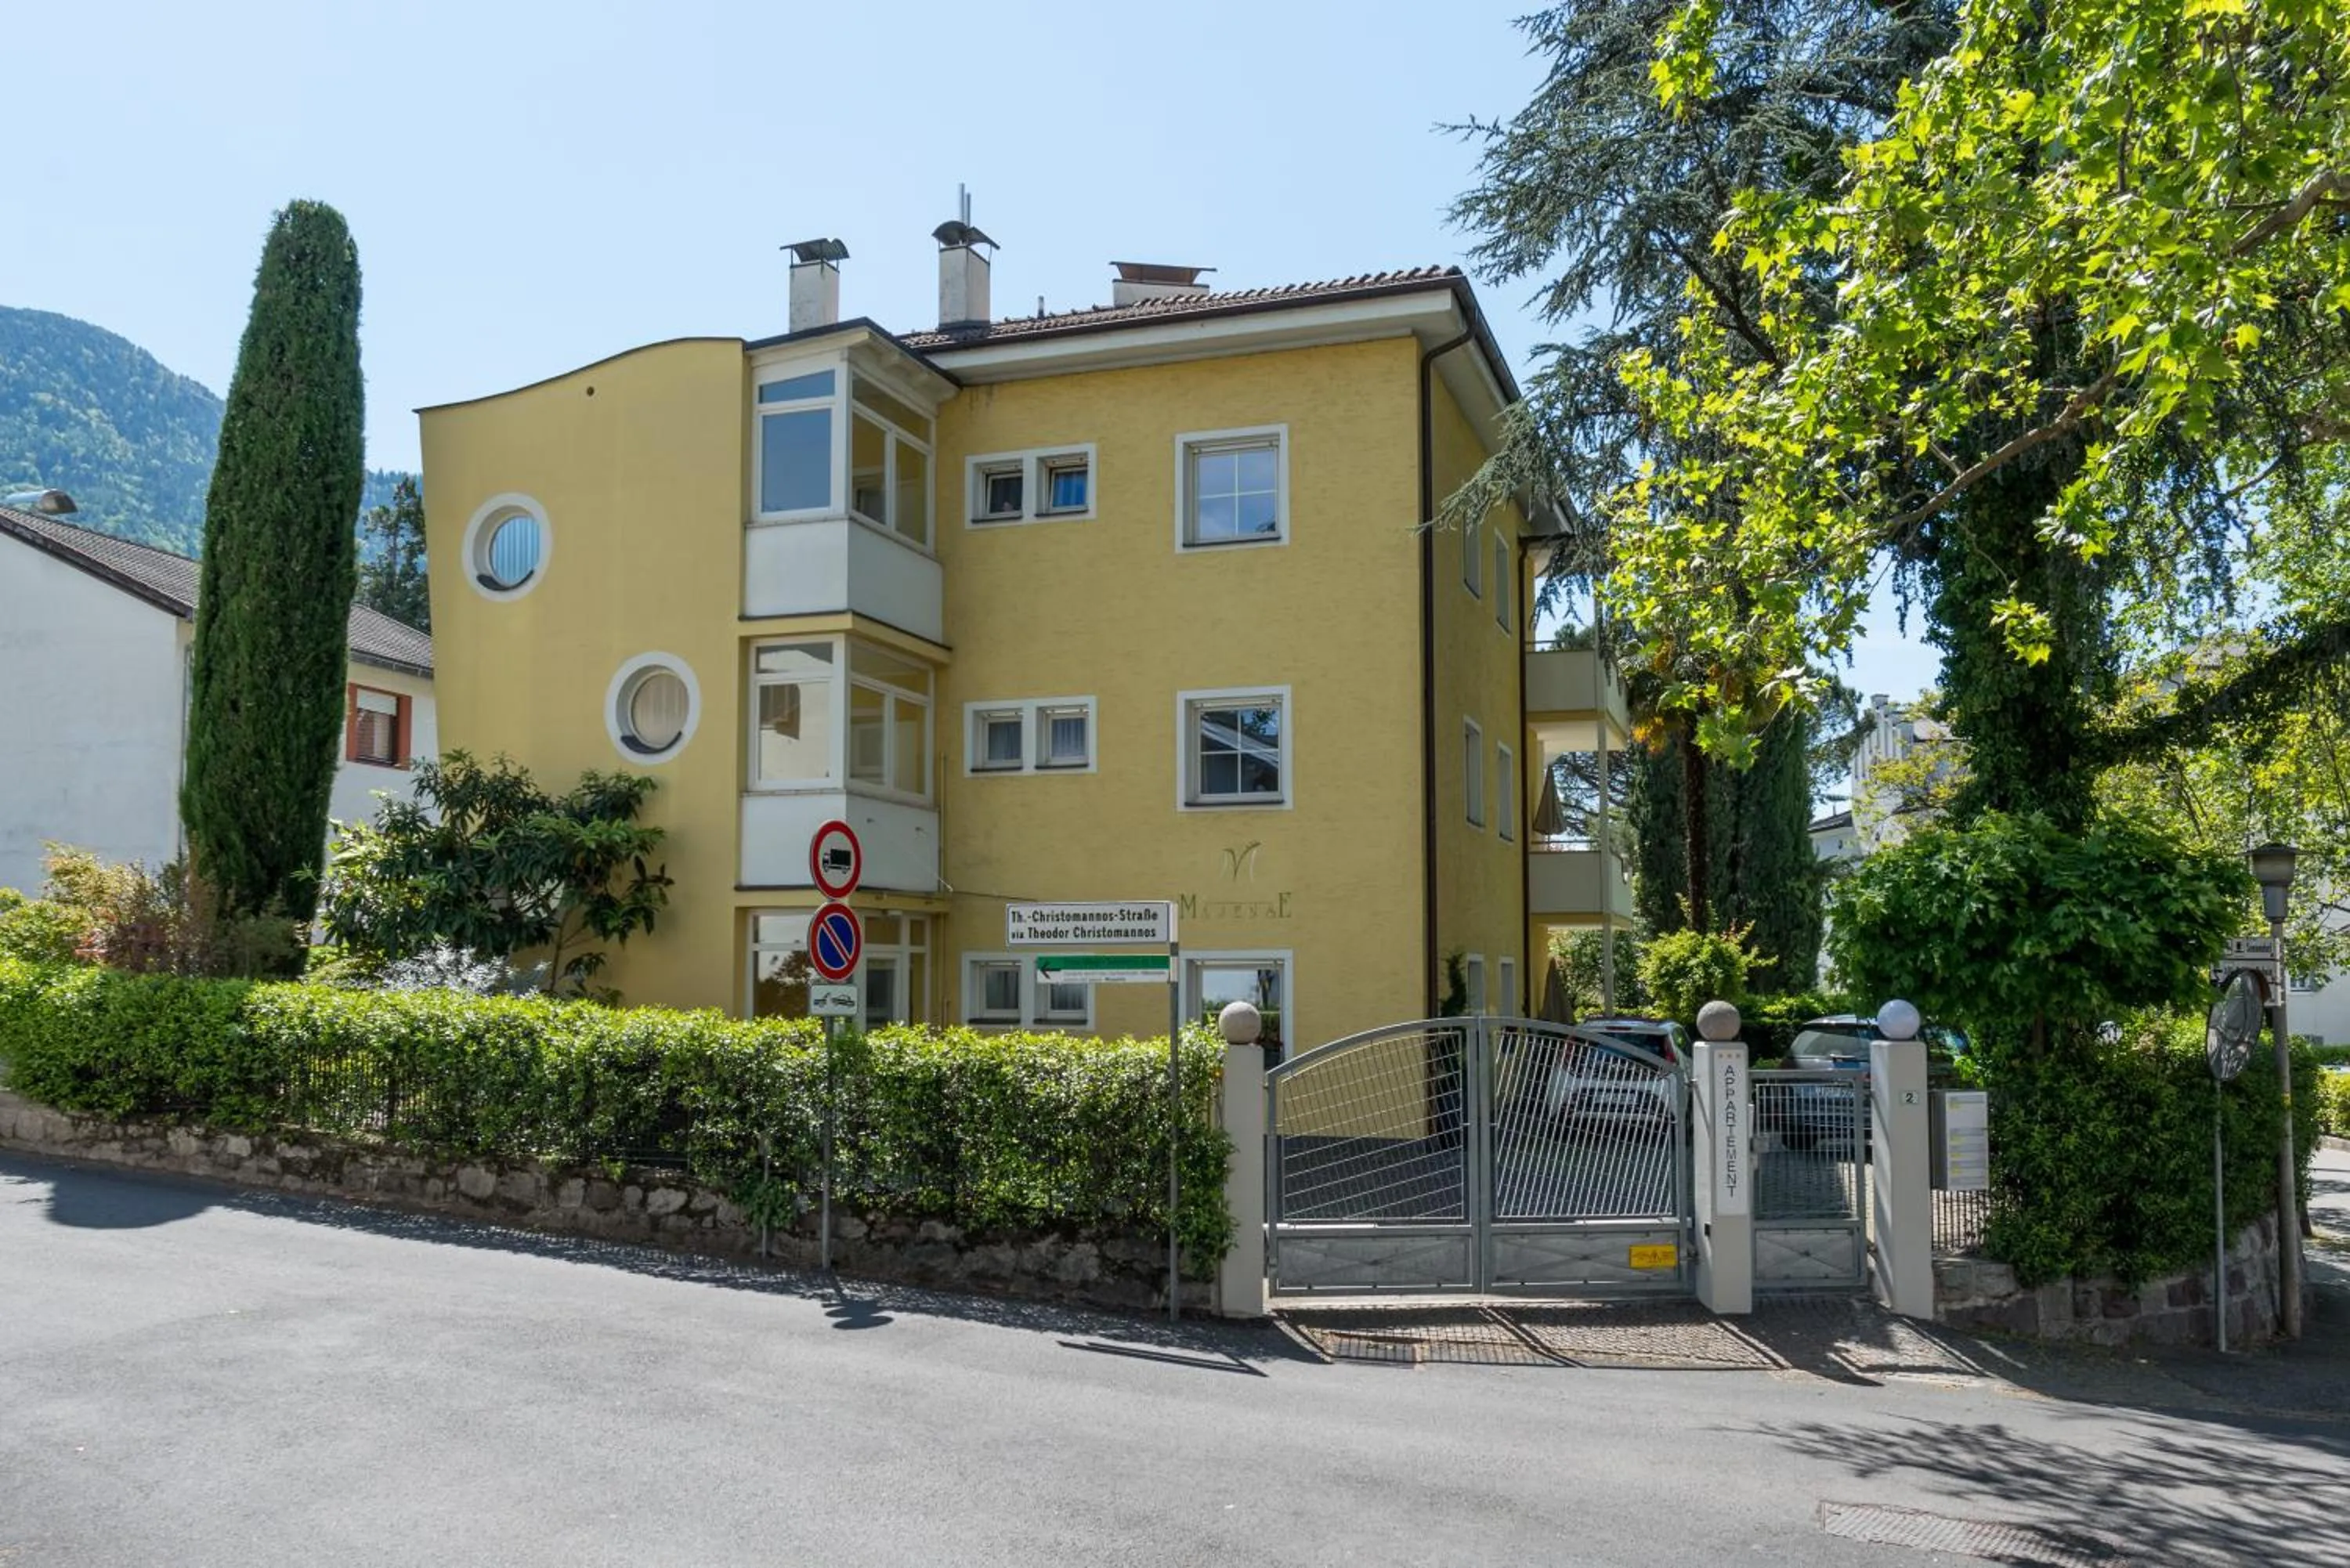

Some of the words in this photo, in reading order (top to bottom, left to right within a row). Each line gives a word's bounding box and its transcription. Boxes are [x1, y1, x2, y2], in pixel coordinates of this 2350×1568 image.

[1028, 927, 1069, 939] Theodor
[1073, 926, 1156, 939] Christomannos
[1905, 1093, 1914, 1104] 2
[1725, 1064, 1737, 1198] APPARTEMENT
